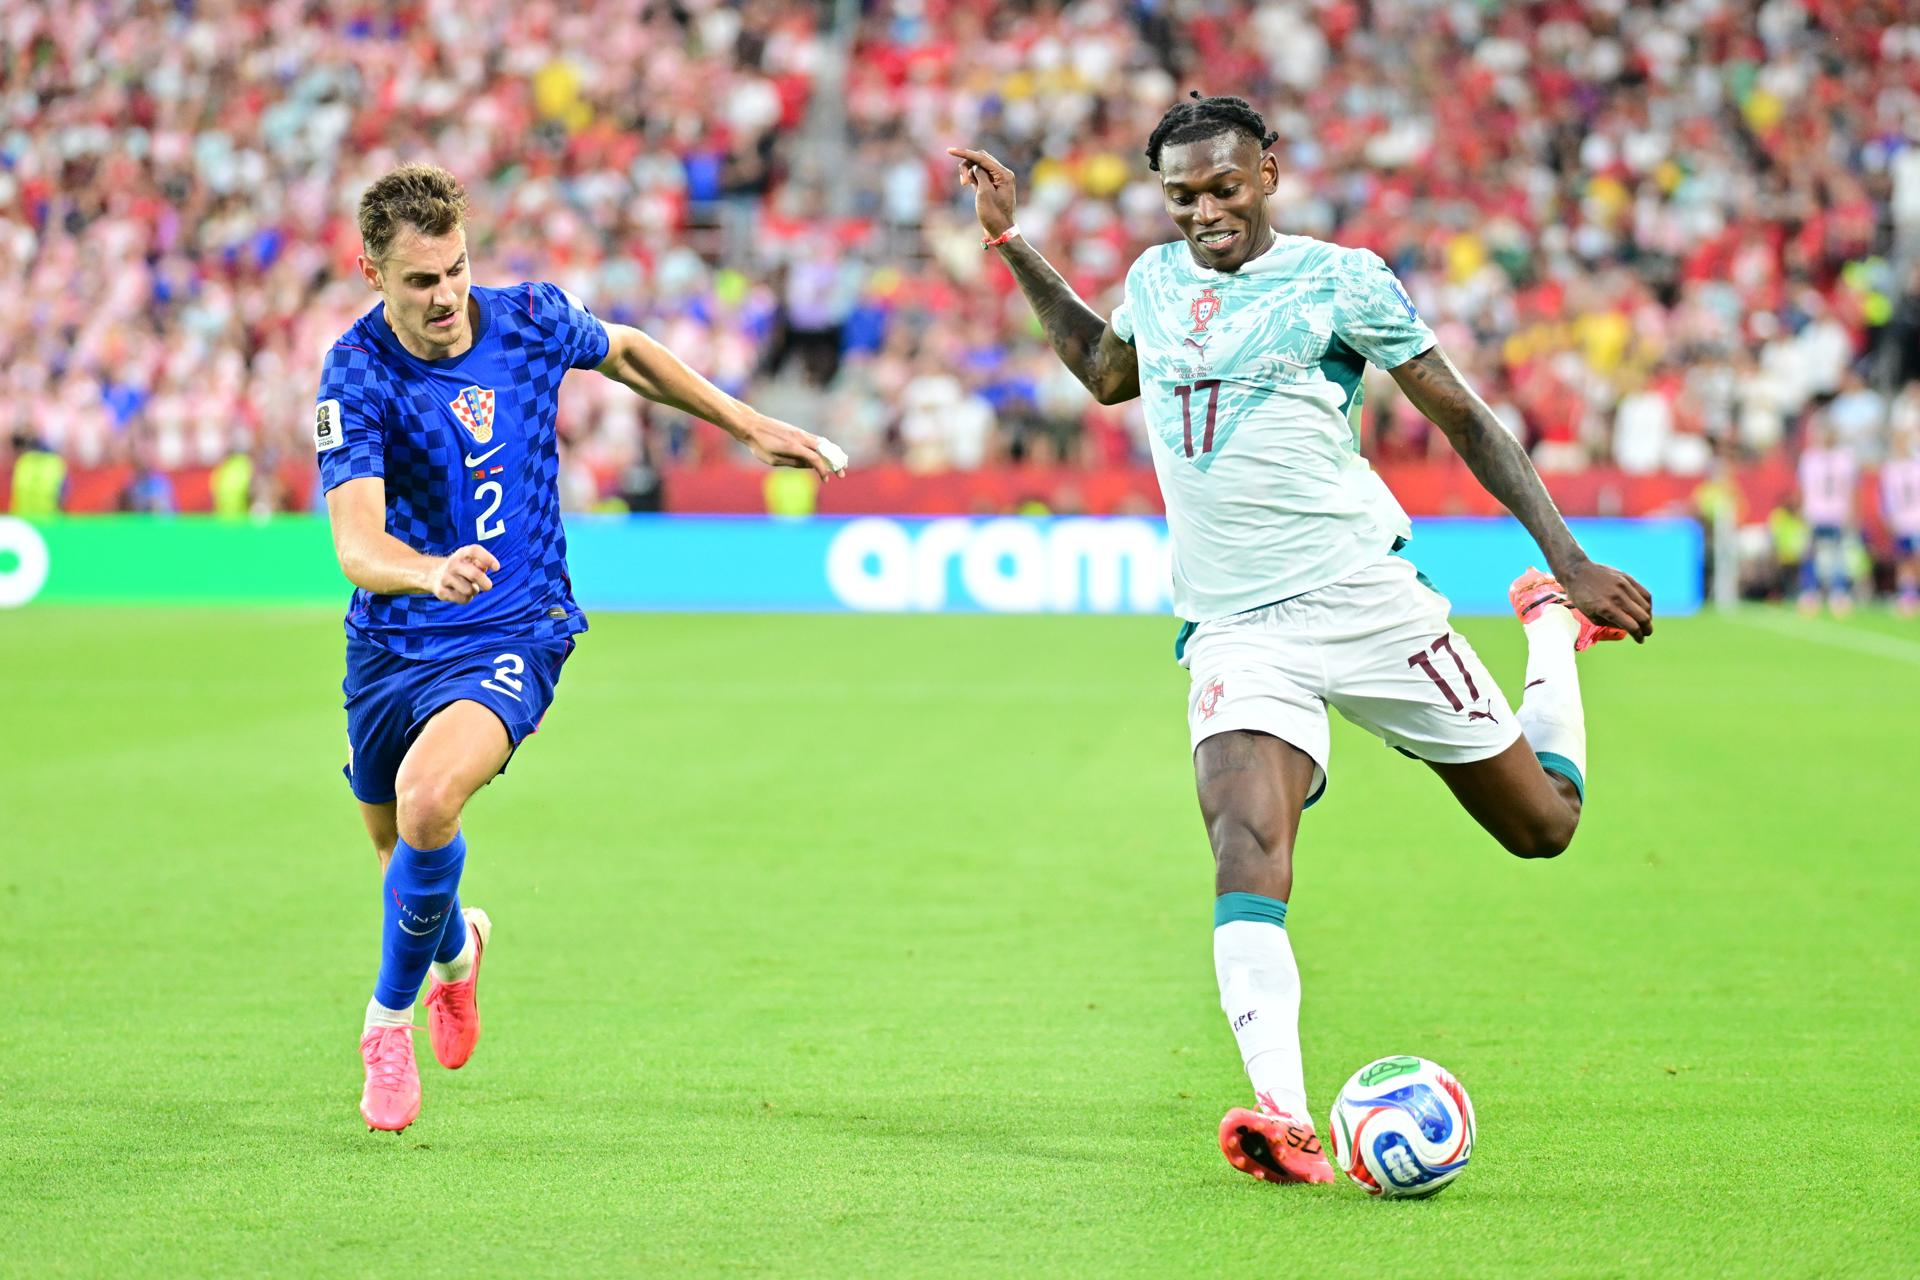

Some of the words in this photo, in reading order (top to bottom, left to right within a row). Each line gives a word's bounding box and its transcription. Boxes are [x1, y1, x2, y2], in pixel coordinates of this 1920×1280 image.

[1174, 379, 1222, 458] 17
[474, 481, 506, 541] 2
[825, 516, 1175, 612] aram
[493, 653, 525, 693] 2
[1407, 632, 1480, 713] 17
[402, 904, 441, 924] HNS
